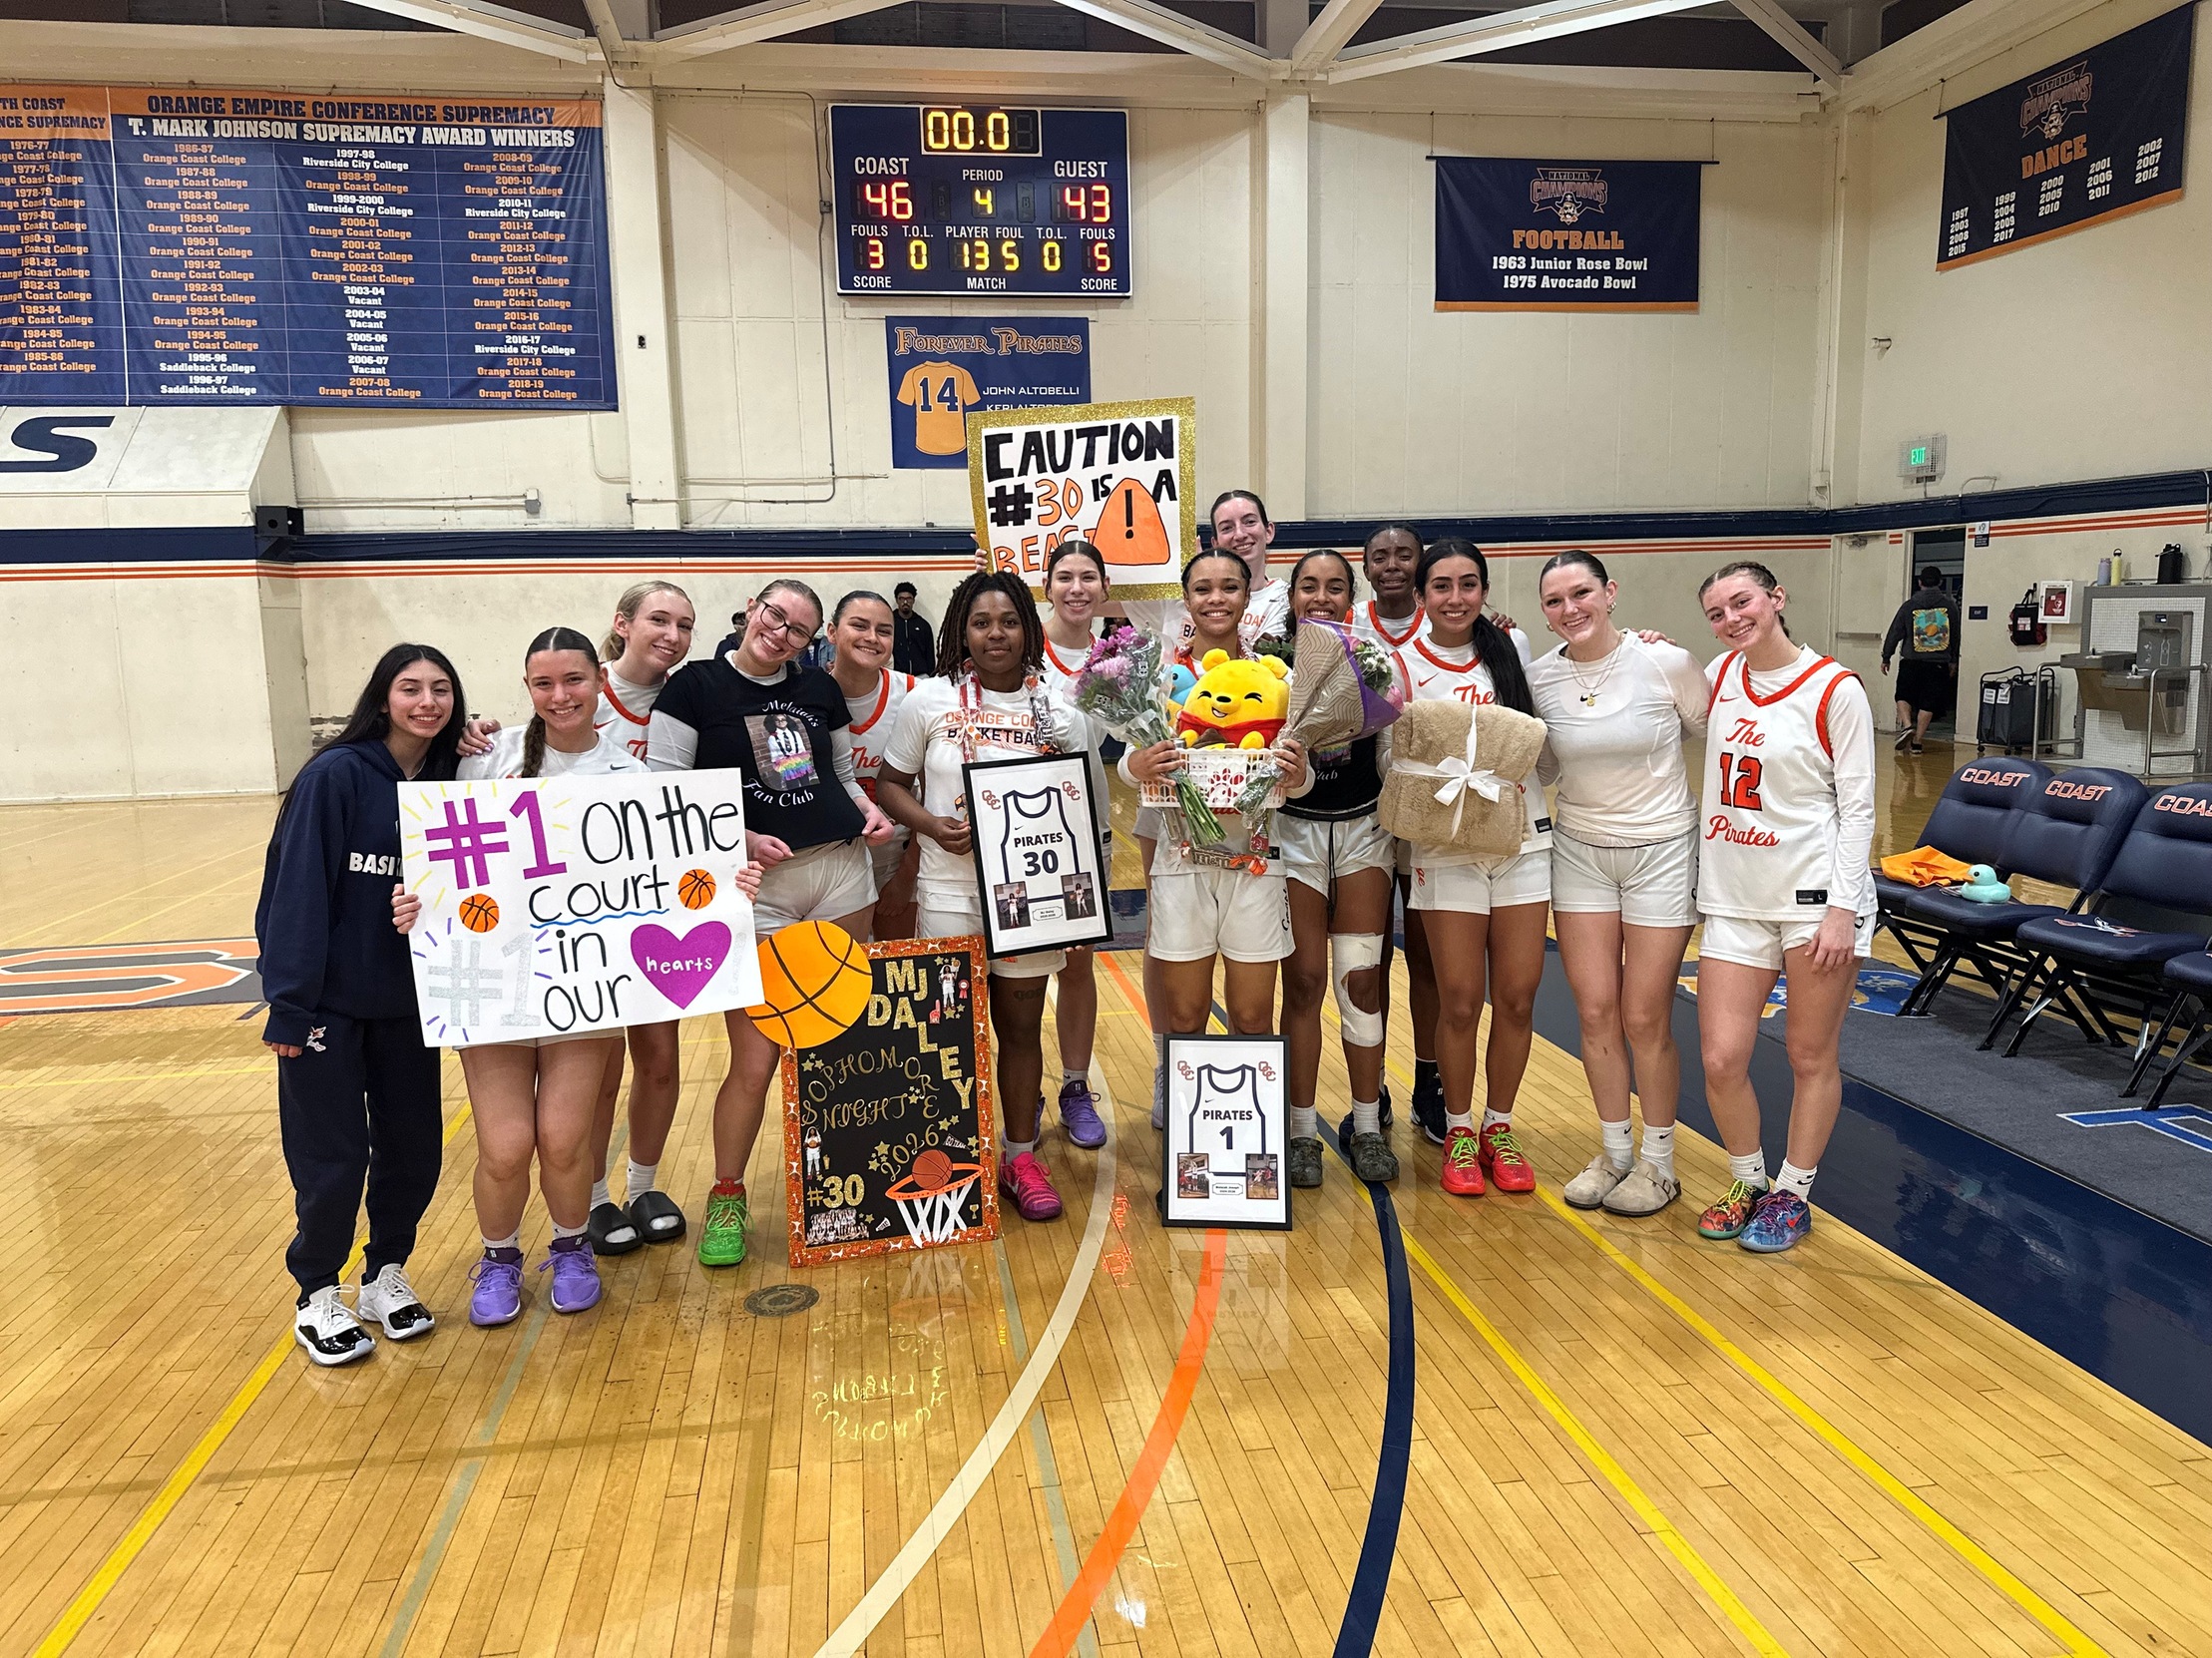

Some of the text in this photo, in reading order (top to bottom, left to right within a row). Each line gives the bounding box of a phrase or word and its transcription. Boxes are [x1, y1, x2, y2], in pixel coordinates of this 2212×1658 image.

[22, 98, 65, 111] COAST
[148, 95, 556, 125] ORANGE EMPIRE CONFERENCE SUPREMACY
[27, 116, 106, 129] SUPREMACY
[128, 118, 576, 148] T. MARK JOHNSON SUPREMACY AWARD WINNERS
[336, 149, 375, 160] 1997-98
[2021, 134, 2088, 180] DANCE
[302, 157, 409, 172] Riverside City College
[854, 157, 910, 176] COAST
[1054, 161, 1108, 178] GUEST
[962, 169, 1004, 182] PERIOD
[1548, 171, 1590, 181] NATIONAL
[1952, 137, 2163, 221] 1997 1999 2000 2001 2002
[332, 194, 384, 206] 1999-2000
[1532, 179, 1607, 203] CHAMPIONS
[1950, 152, 2161, 234] 2003 2004 2005 2006 2007
[498, 199, 532, 208] 2010-11
[865, 182, 913, 219] 46
[974, 188, 993, 214] 4
[1064, 185, 1110, 222] 43
[1949, 166, 2159, 246] 2008 2009 2010 2011 2012
[307, 203, 414, 217] Riverside City College
[465, 207, 567, 219] Riverside City College
[851, 224, 889, 237] FOULS
[902, 225, 934, 238] T.O.L.
[946, 225, 1025, 239] PLAYER FOUL
[1037, 227, 1068, 239] T.O.L.
[1080, 227, 1115, 240] FOULS
[1513, 229, 1624, 250] FOOTBALL
[1948, 228, 2014, 257] 2015 2017
[868, 239, 884, 269] 3
[909, 239, 928, 269] 0
[1043, 241, 1061, 271] 0
[1095, 242, 1110, 271] 5
[1493, 256, 1648, 271] 1963 Junior Rose Bowl
[343, 285, 386, 296] 2003-04
[853, 275, 892, 288] SCORE
[967, 277, 1007, 290] MATCH
[1081, 278, 1117, 291] SCORE
[1503, 275, 1636, 289] 1975 Avocado Bowl
[347, 295, 382, 305] Vacant
[344, 309, 387, 319] 2004-05
[349, 319, 384, 329] Vacant
[346, 332, 388, 342] 2005-06
[505, 335, 541, 344] 2016-17
[350, 342, 385, 352] Vacant
[474, 344, 576, 356] Riverside City College
[188, 353, 227, 362] 1995-96
[160, 362, 256, 374] Saddleback College
[189, 375, 228, 384] 1996-97
[508, 379, 545, 389] 2018-19
[160, 384, 257, 396] Saddleback College
[479, 389, 578, 401] Orange Coast College
[918, 376, 960, 414] 14
[982, 386, 1080, 395] JOHN ALTOBELLI
[984, 418, 1174, 483] CAUTION
[1911, 447, 1927, 465] EXIT
[987, 469, 1177, 527] #30 IS A
[1453, 682, 1495, 705] The
[1724, 717, 1766, 748] The
[1718, 751, 1763, 812] 12
[1960, 767, 2031, 788] COAST
[741, 777, 814, 808] Fan Club
[2044, 780, 2113, 801] COAST
[424, 784, 740, 890] #1 on the
[1014, 832, 1064, 848] PIRATES
[1704, 814, 1780, 848] Pirates
[1023, 849, 1059, 877] 30
[529, 864, 669, 923] court
[646, 956, 713, 975] hearts
[428, 930, 608, 1028] #1 in
[885, 959, 929, 1002] MJ
[544, 974, 633, 1032] our
[867, 994, 975, 1110] DALEY
[822, 1093, 910, 1133] NIGHT
[1202, 1109, 1253, 1121] PIRATES
[1218, 1125, 1233, 1150] 1
[880, 1123, 940, 1183] 2026
[806, 1172, 865, 1209] #30
